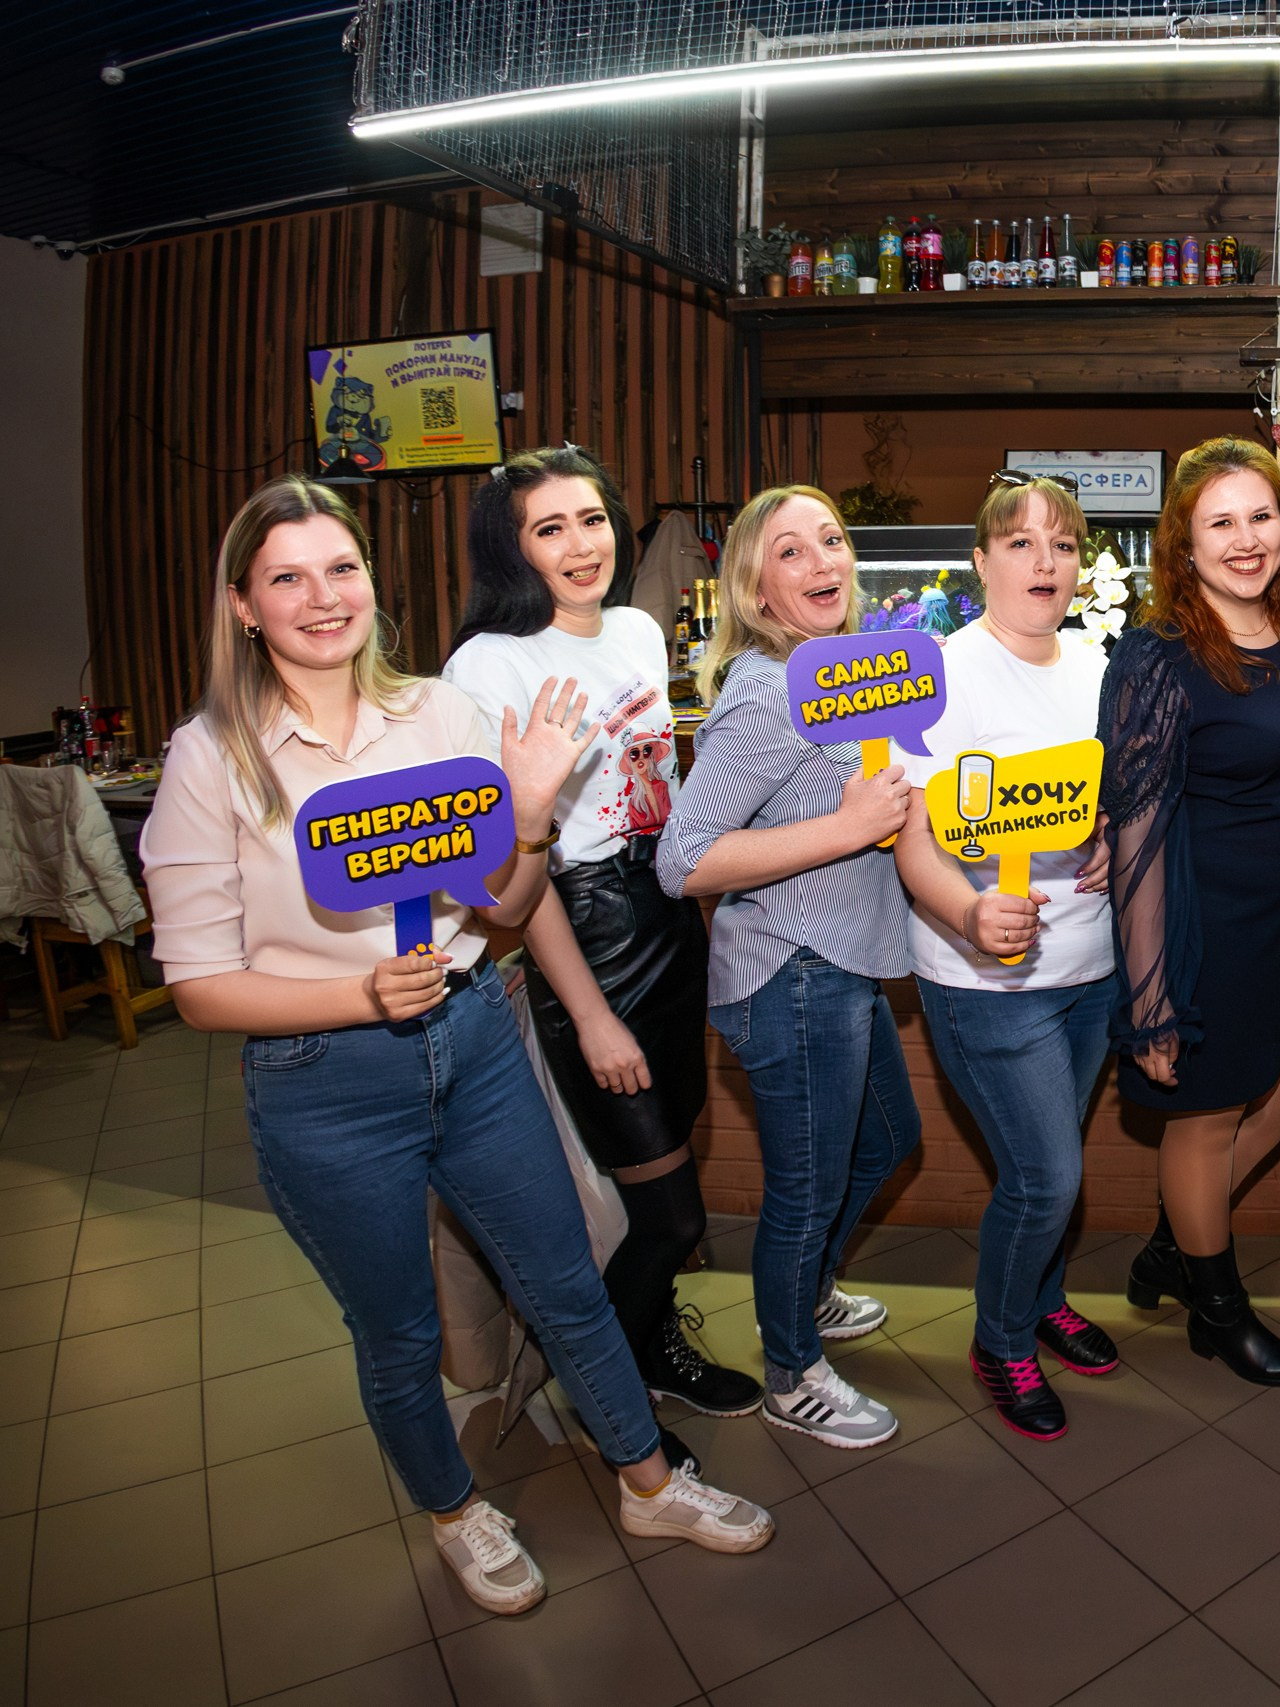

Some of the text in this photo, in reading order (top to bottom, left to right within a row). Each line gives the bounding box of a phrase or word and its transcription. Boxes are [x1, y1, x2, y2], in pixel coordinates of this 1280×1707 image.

[385, 354, 437, 377] ПОКОРМИ
[390, 364, 486, 388] И ВЫИГРАЙ ПРИЗ!
[1034, 471, 1148, 488] СФЕРА
[815, 649, 911, 690] САМАЯ
[800, 673, 936, 727] КРАСИВАЯ
[998, 780, 1087, 807] ХОЧУ
[308, 785, 502, 850] ГЕНЕРАТОР
[944, 804, 1089, 842] ШАМПАНСКОГО!
[345, 822, 476, 882] ВЕРСИЙ
